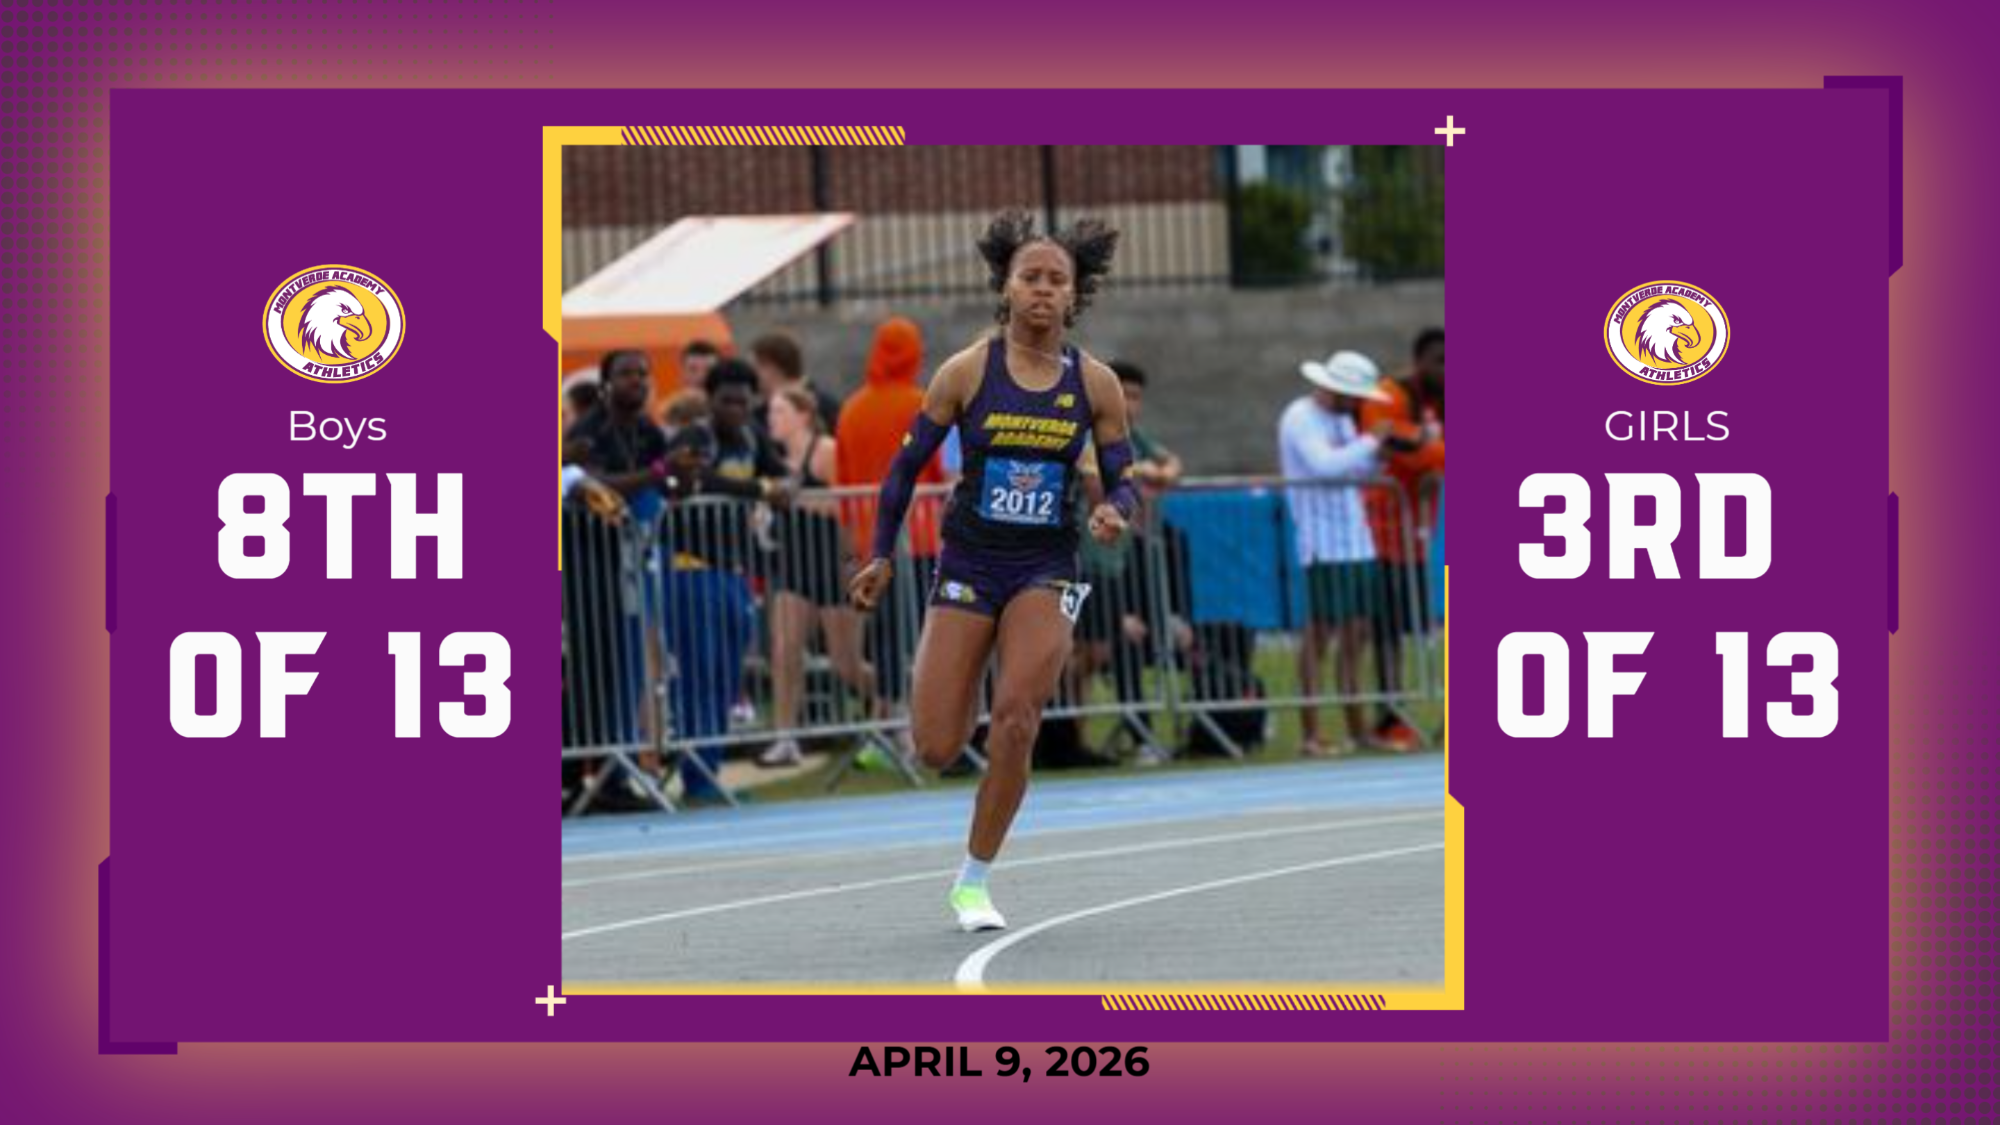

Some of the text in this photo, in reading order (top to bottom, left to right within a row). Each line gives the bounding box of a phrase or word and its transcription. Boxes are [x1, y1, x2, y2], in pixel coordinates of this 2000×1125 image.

[984, 413, 1078, 436] MONTVERDE
[991, 431, 1071, 451] ACADEMY
[990, 486, 1055, 516] 2012
